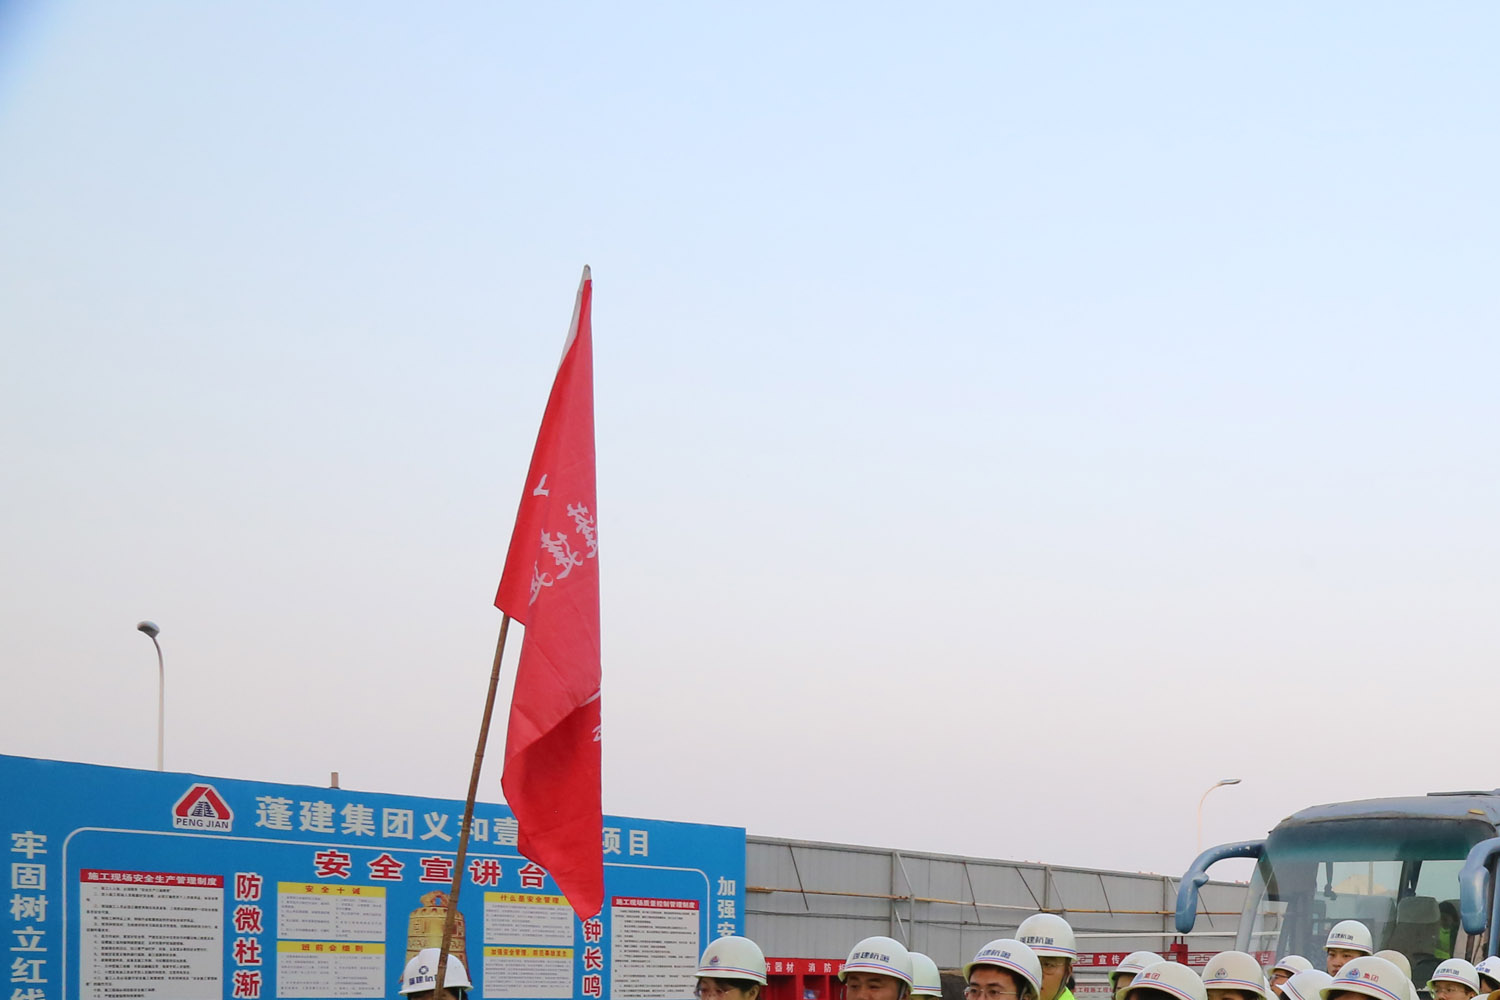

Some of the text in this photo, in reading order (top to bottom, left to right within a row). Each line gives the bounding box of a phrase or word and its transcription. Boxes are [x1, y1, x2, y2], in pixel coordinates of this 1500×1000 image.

[176, 818, 229, 830] PENG JIAN
[314, 850, 547, 889] 安全宣讲台
[87, 871, 217, 886] 施工现场安全生产管理制度
[233, 872, 262, 998] 防微杜渐
[583, 918, 603, 998] 钟长鸣
[766, 961, 794, 973] 防器材
[1363, 972, 1379, 982] 集团
